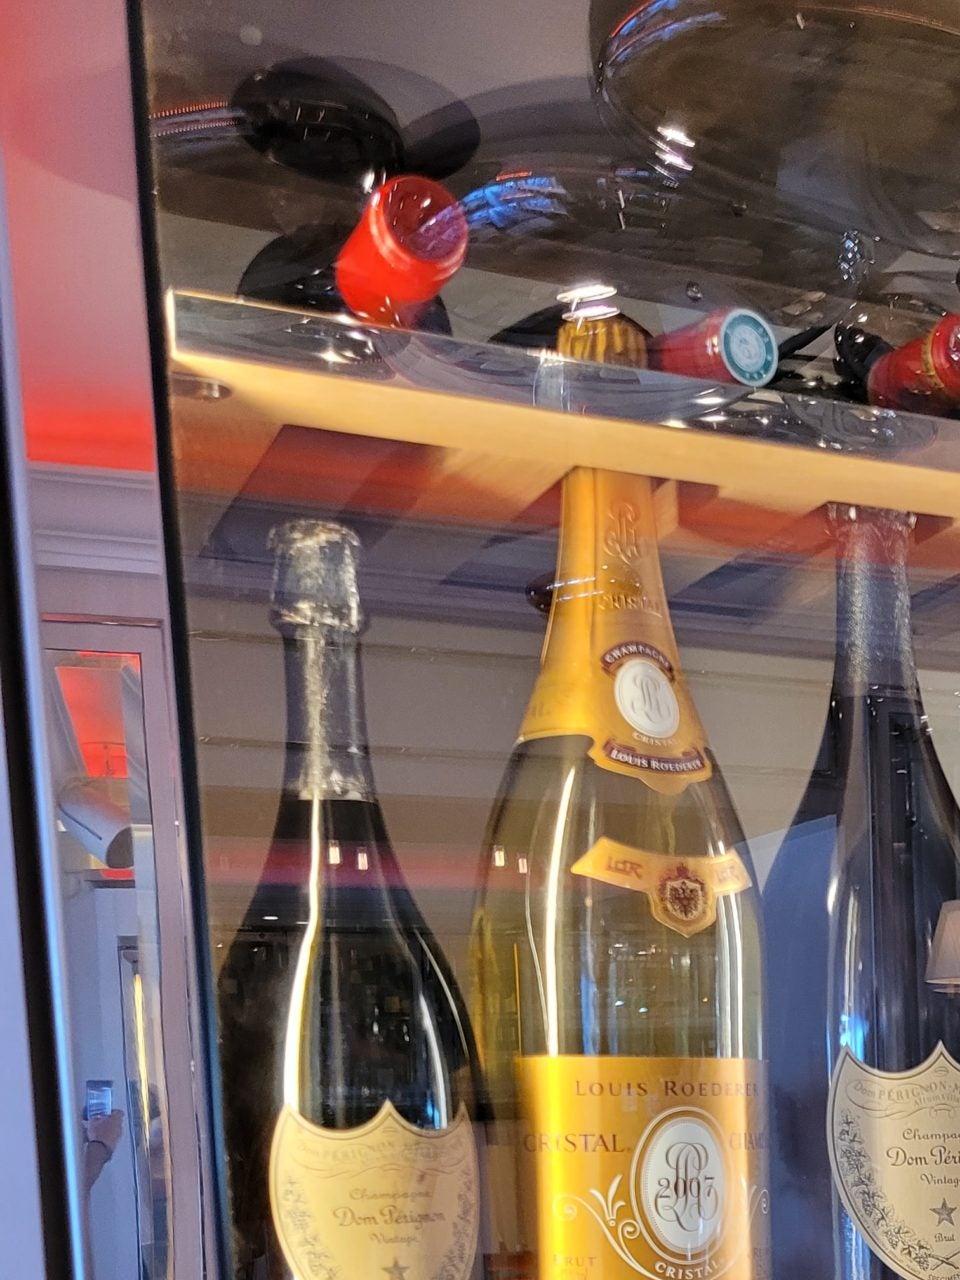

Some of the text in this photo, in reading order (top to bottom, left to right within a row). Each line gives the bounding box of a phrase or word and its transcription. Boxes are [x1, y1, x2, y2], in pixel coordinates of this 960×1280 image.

[610, 748, 649, 769] LOUIS
[575, 1080, 648, 1097] LOUIS
[523, 1133, 627, 1154] CRISTAL
[886, 1146, 929, 1167] Dom
[349, 1187, 433, 1202] Champagne
[657, 1176, 715, 1199] 2007
[333, 1206, 379, 1228] Dom
[370, 1233, 420, 1245] Vintage
[934, 1232, 956, 1243] Brut
[654, 1260, 722, 1280] CRISTAL
